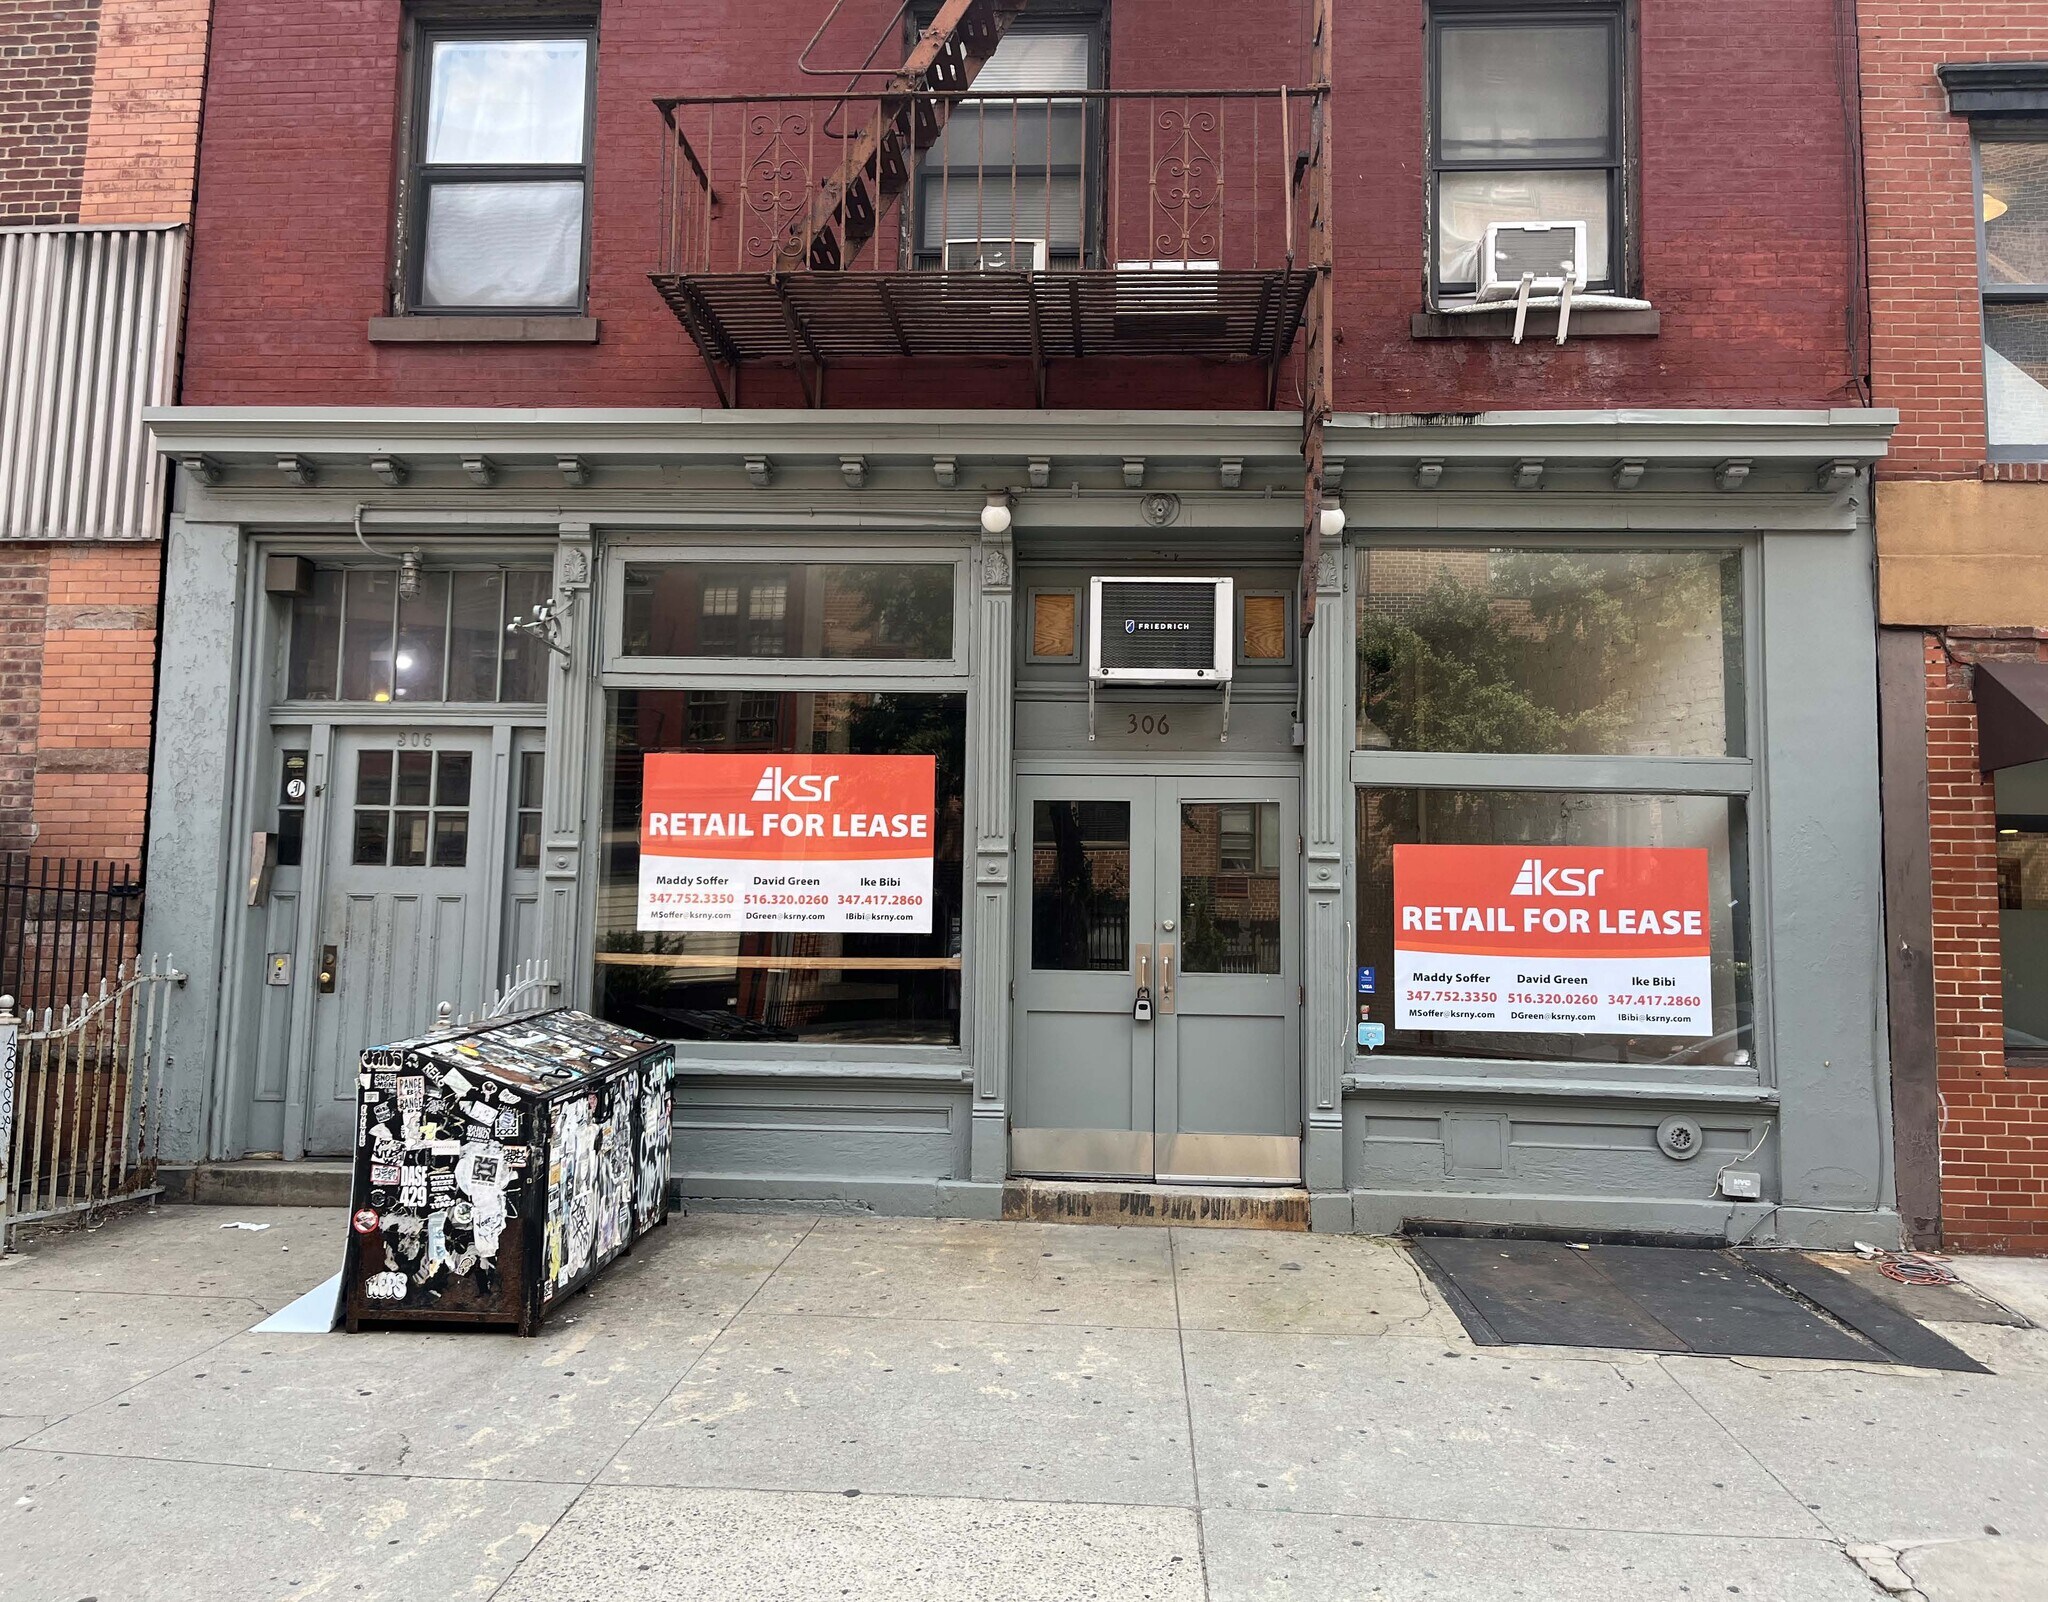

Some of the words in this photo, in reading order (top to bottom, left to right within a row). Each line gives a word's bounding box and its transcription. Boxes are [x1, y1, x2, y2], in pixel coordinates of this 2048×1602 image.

[1126, 713, 1170, 735] 306
[397, 732, 433, 747] 306
[649, 812, 754, 837] RETAIL
[762, 813, 824, 838] FOR
[832, 814, 927, 838] LEASE
[656, 876, 694, 887] Maddy
[696, 876, 729, 886] Soffer
[753, 876, 785, 886] David
[787, 876, 820, 886] Green
[860, 877, 877, 887] Ike
[879, 877, 901, 887] Bibi
[649, 893, 735, 904] 347.752.3350
[743, 894, 829, 905] 516.320.0260
[837, 894, 923, 906] 347.417.2860
[650, 911, 732, 921] MSoffer@ksrny.com
[745, 912, 826, 922] DGreen@ksrny.com
[845, 912, 914, 922] IBibi@ksrny.com
[1402, 906, 1515, 932] RETAIL
[1523, 908, 1591, 934] FOR
[1598, 909, 1702, 936] LEASE
[1412, 972, 1453, 985] Maddy
[1455, 973, 1491, 984] Soffer
[1517, 974, 1551, 984] David
[1553, 974, 1588, 985] Green
[1632, 976, 1650, 986] Ike
[1652, 976, 1676, 987] Bibi
[1406, 990, 1498, 1003] 347.752.3350
[1507, 992, 1599, 1005] 516.320.0260
[1607, 994, 1701, 1007] 347.417.2860
[1409, 1009, 1496, 1020] MSoffer@ksrny.com
[1510, 1011, 1596, 1022] DGreen@ksrny.com
[1618, 1013, 1692, 1024] IBibi@ksrny.com
[400, 1165, 428, 1187] DASE
[399, 1186, 428, 1208] 429
